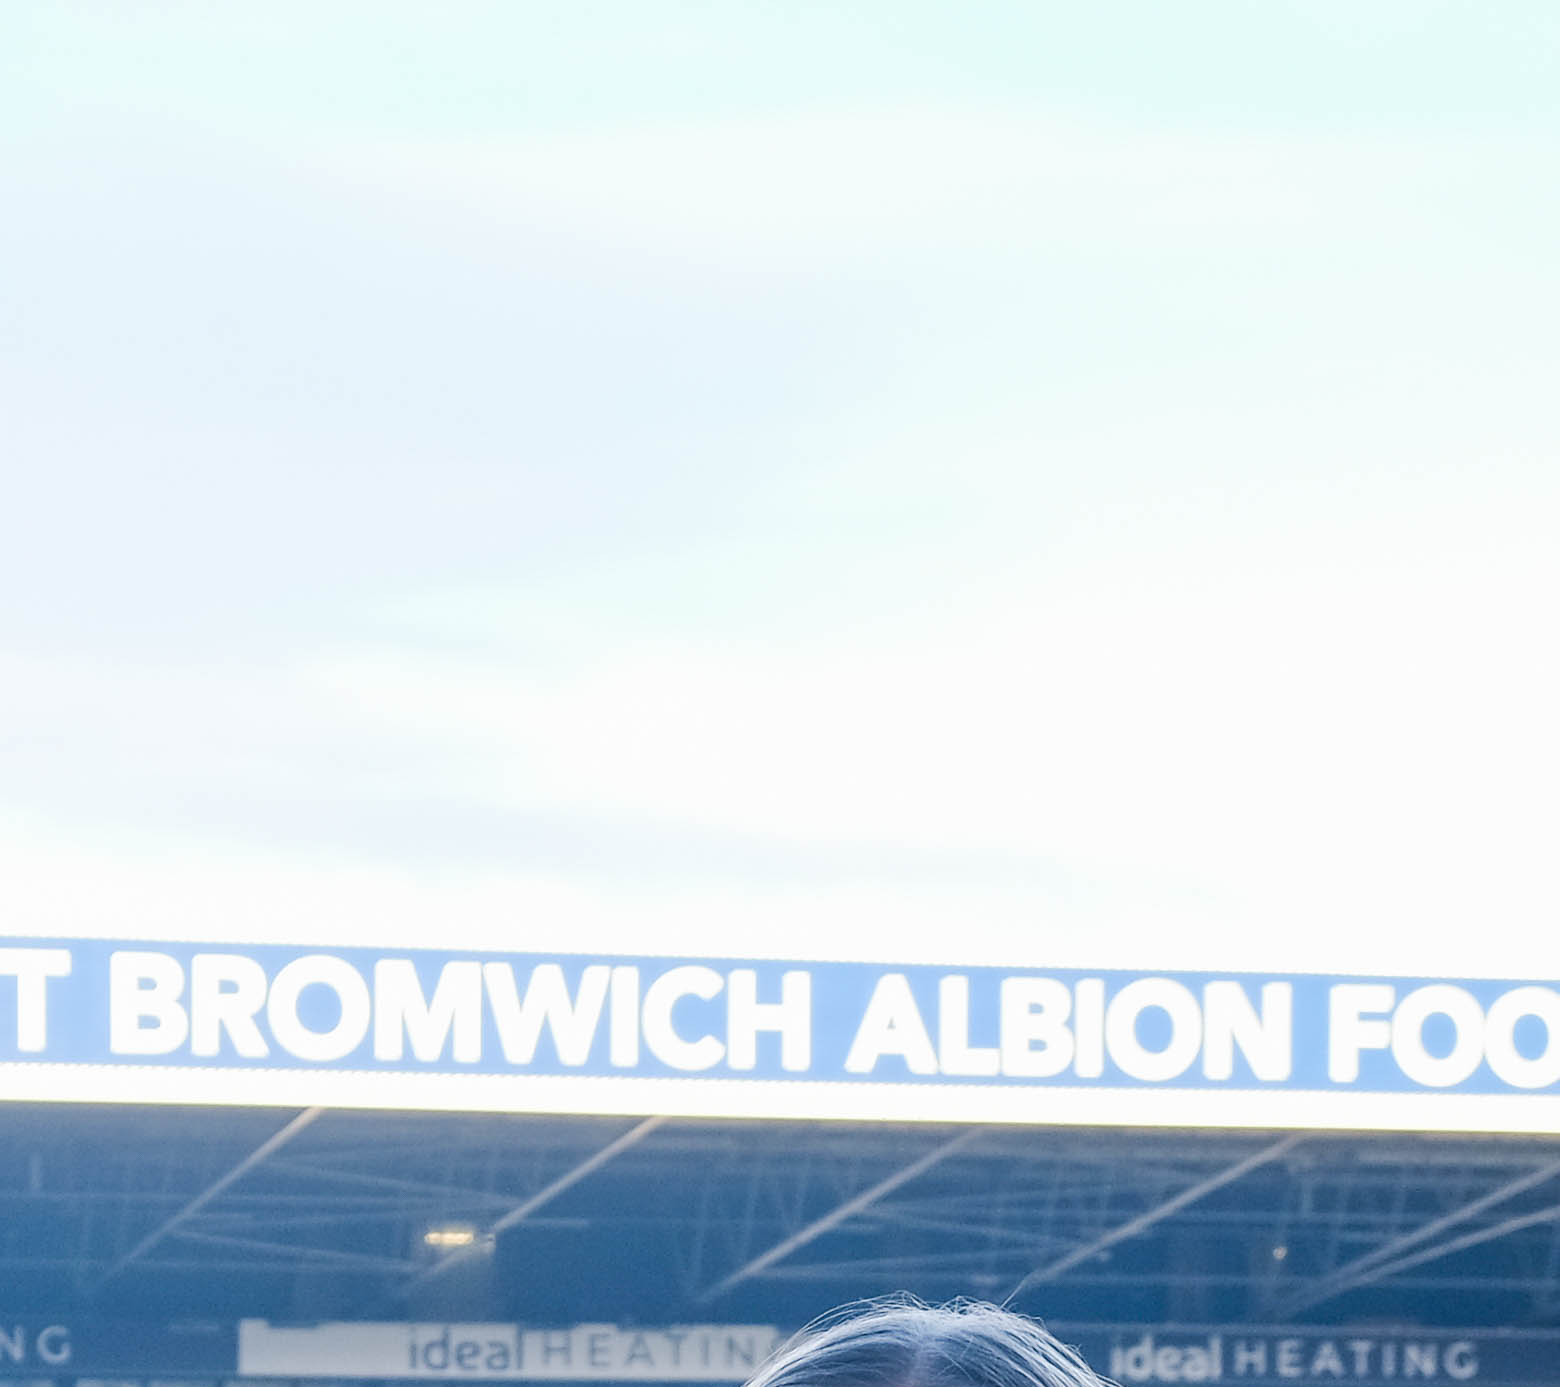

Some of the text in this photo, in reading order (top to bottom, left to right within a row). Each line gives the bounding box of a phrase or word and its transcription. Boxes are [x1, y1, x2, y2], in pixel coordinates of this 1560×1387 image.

[108, 950, 812, 1071] BROMWICH
[844, 973, 1293, 1082] ALBION
[408, 1331, 773, 1370] ideal HEATIN
[1110, 1336, 1479, 1381] ideal HEATING
